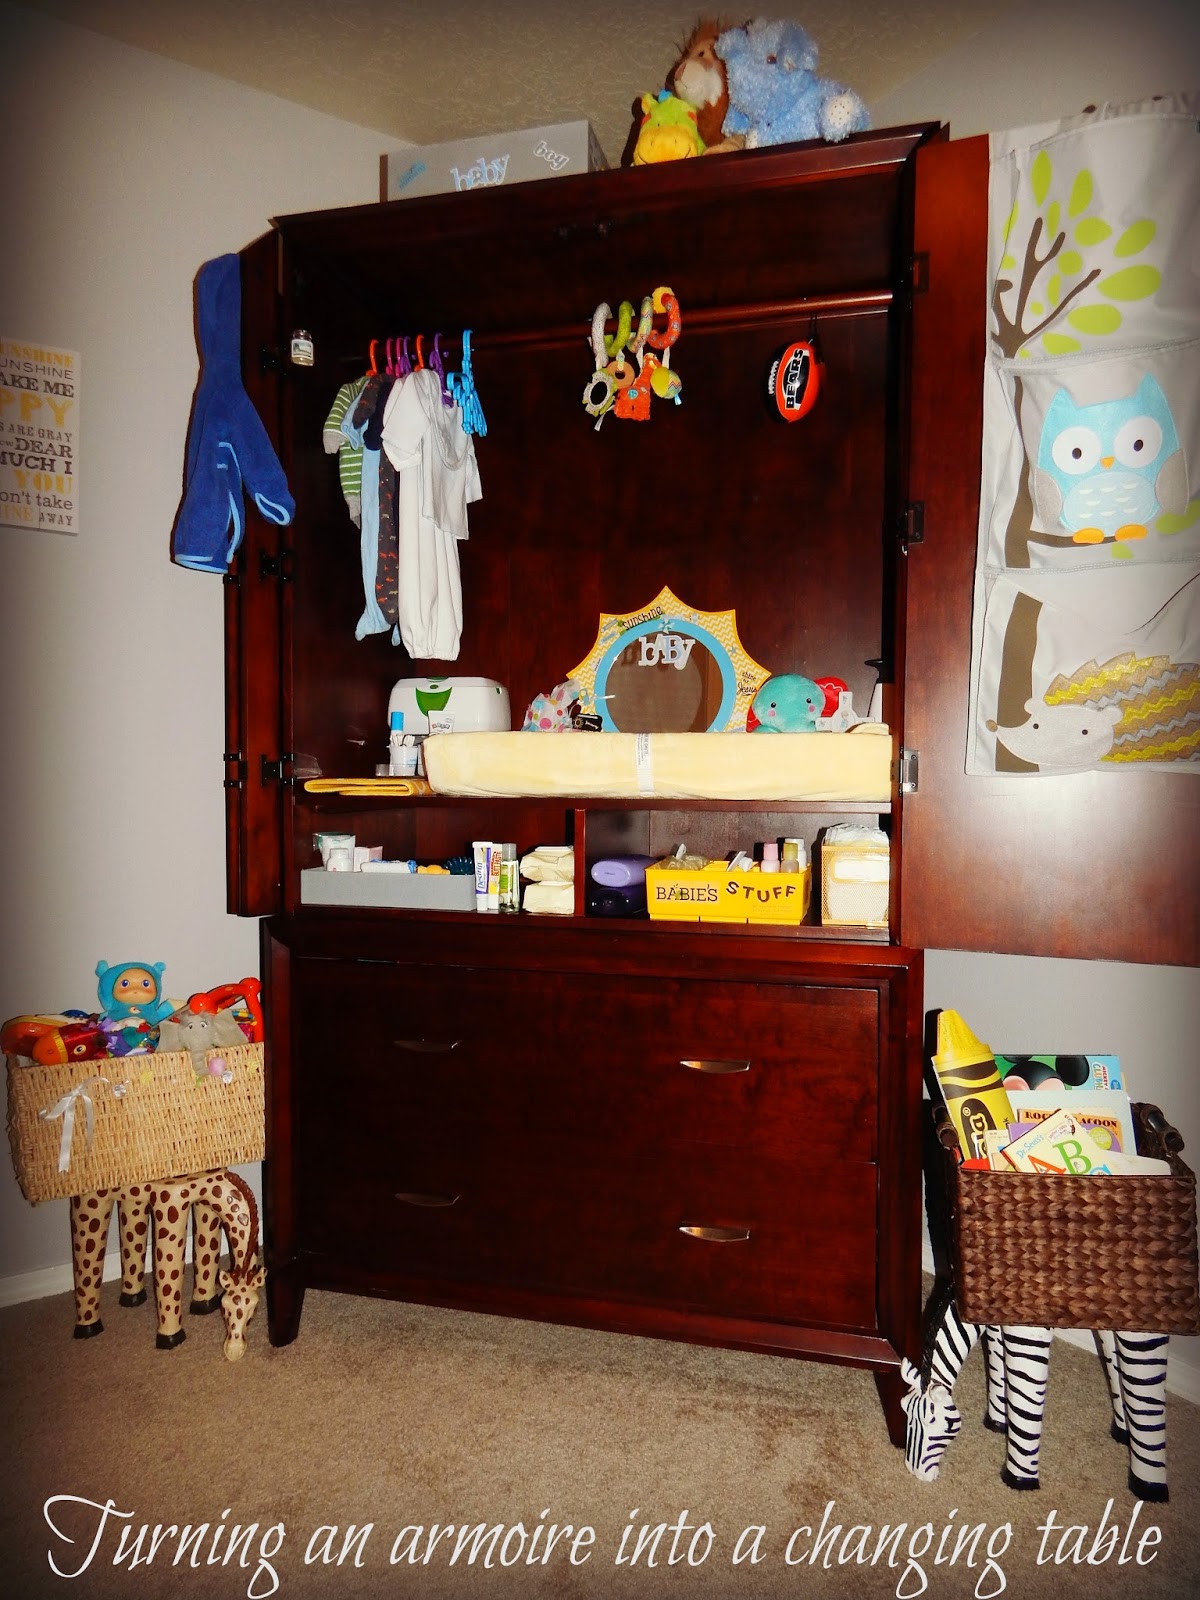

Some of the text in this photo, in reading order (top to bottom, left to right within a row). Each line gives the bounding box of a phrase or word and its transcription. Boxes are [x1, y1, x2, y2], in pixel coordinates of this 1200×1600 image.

[785, 348, 804, 409] BEARS
[43, 380, 74, 398] ME
[9, 424, 34, 437] ARE
[38, 428, 72, 442] GRAY
[15, 437, 73, 458] DEAR
[64, 460, 72, 475] I
[14, 469, 72, 496] YOU
[36, 492, 73, 510] take
[39, 512, 72, 526] AWAY
[726, 881, 796, 903] STUFF
